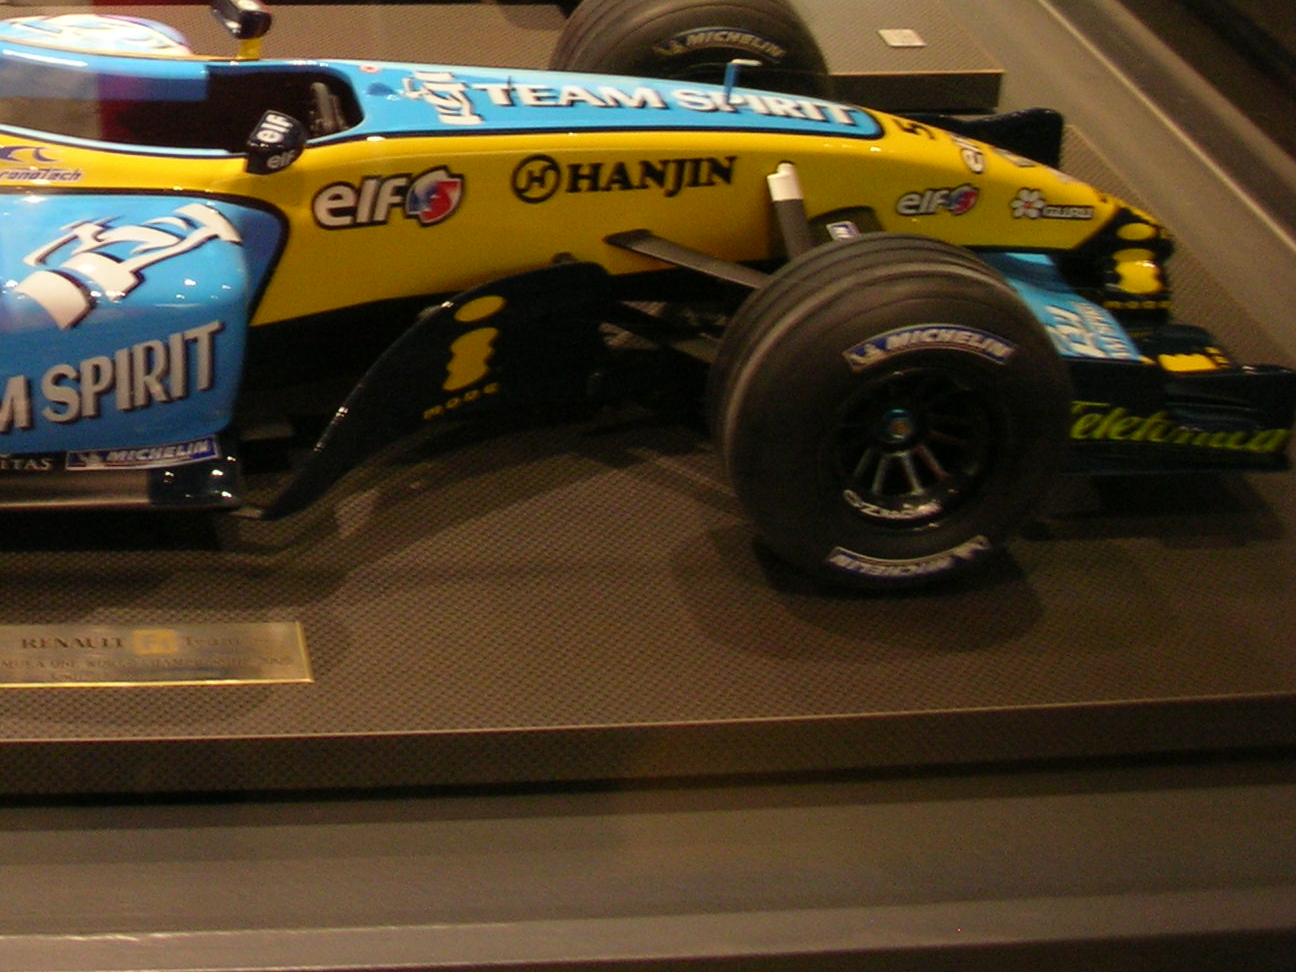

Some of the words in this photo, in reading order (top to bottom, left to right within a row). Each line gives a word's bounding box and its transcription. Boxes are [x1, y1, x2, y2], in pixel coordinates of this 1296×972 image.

[474, 83, 668, 111] TEAM
[670, 87, 858, 127] SPIRIT
[266, 149, 297, 170] elf
[567, 157, 738, 197] HANJIN
[313, 175, 412, 228] elf
[897, 188, 952, 216] elf
[886, 329, 1015, 358] MICHELIN
[41, 320, 226, 425] SPIRIT
[107, 440, 211, 462] MICHELIN
